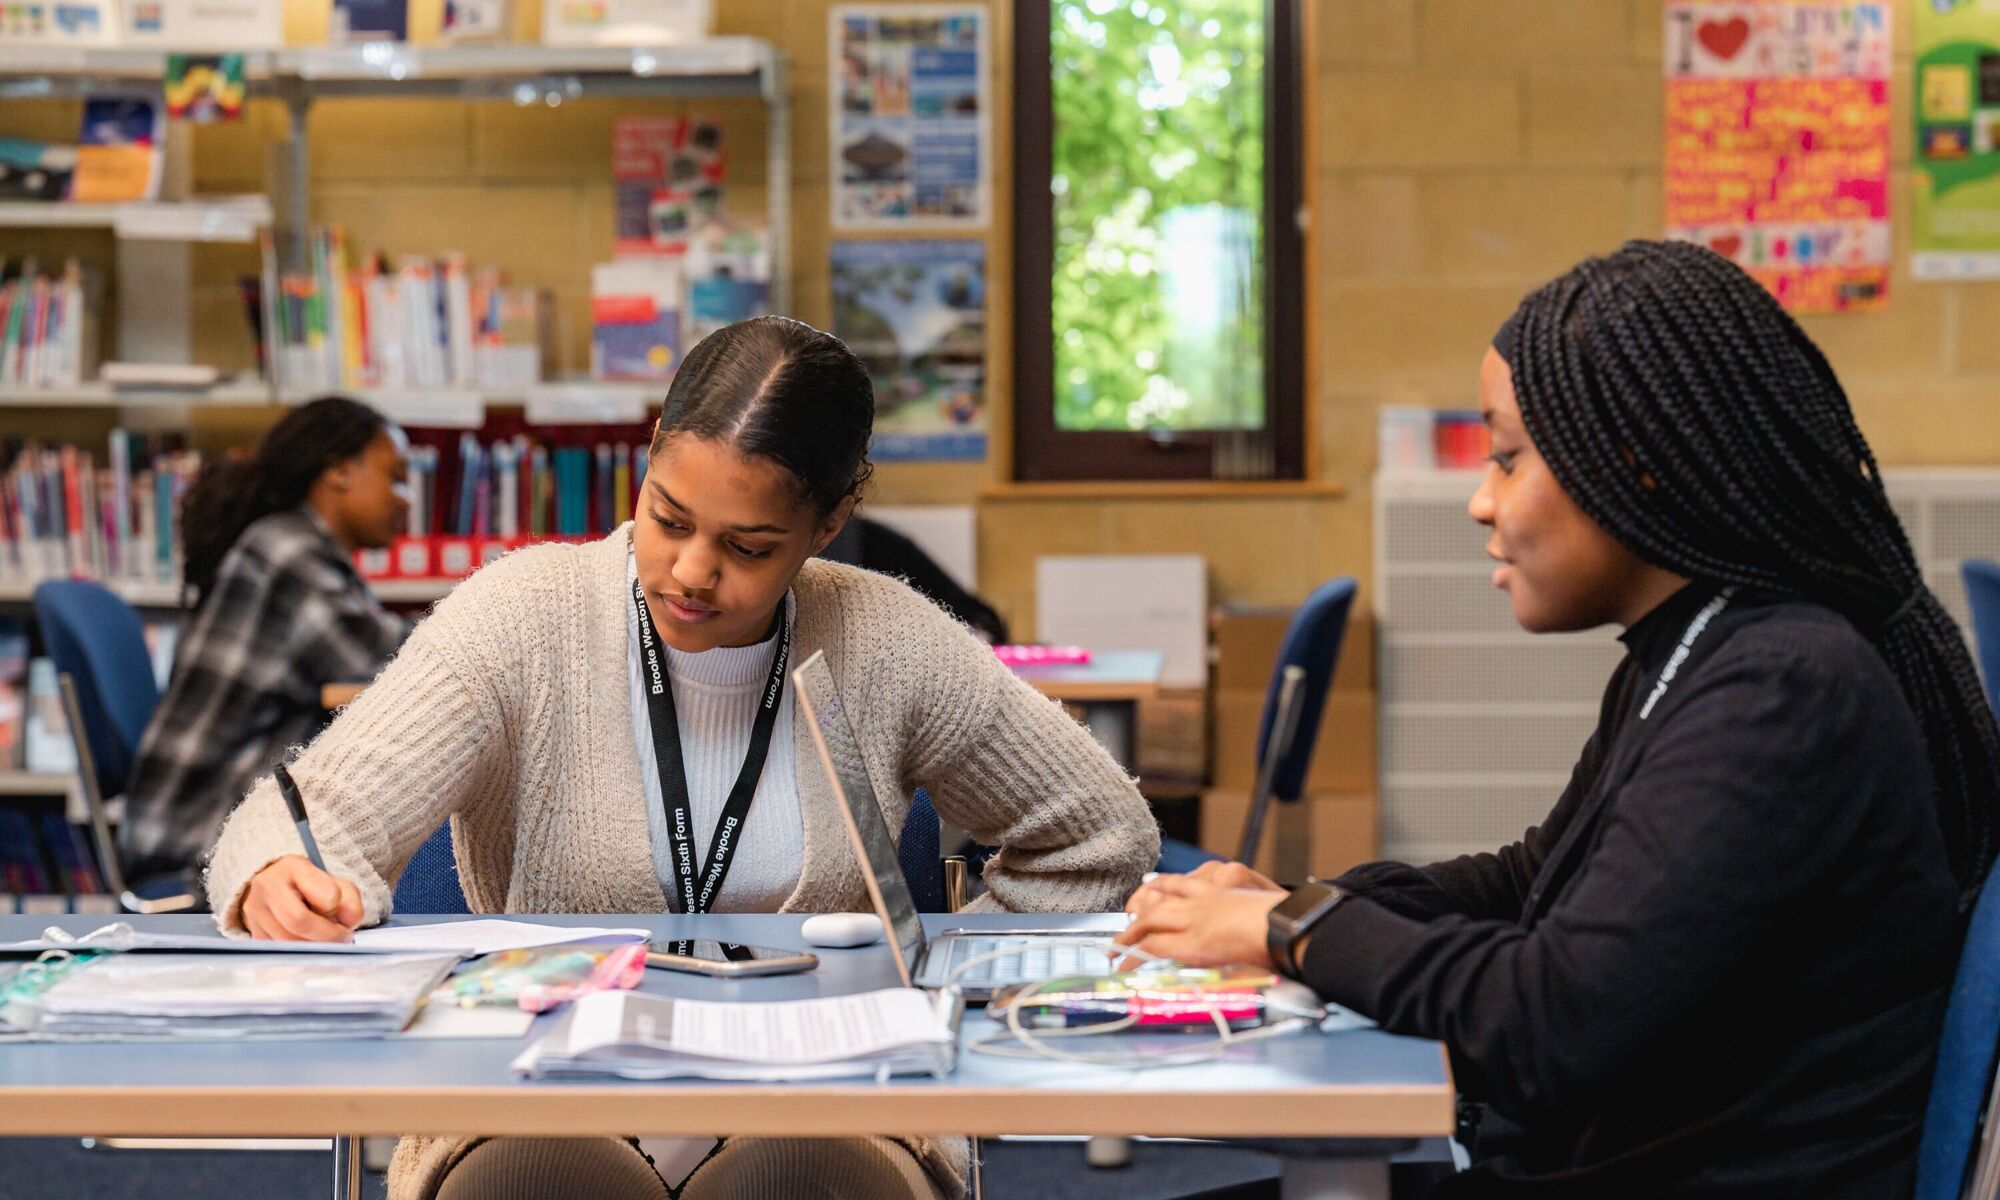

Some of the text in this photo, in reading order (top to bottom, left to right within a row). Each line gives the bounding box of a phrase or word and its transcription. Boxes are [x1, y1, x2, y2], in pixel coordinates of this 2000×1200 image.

[637, 600, 654, 648] Weston
[647, 649, 664, 695] Brooke
[775, 645, 789, 675] Sixth
[765, 677, 780, 709] Form
[675, 807, 695, 914] eston Sixth Form
[699, 816, 738, 907] Brooke Weston
